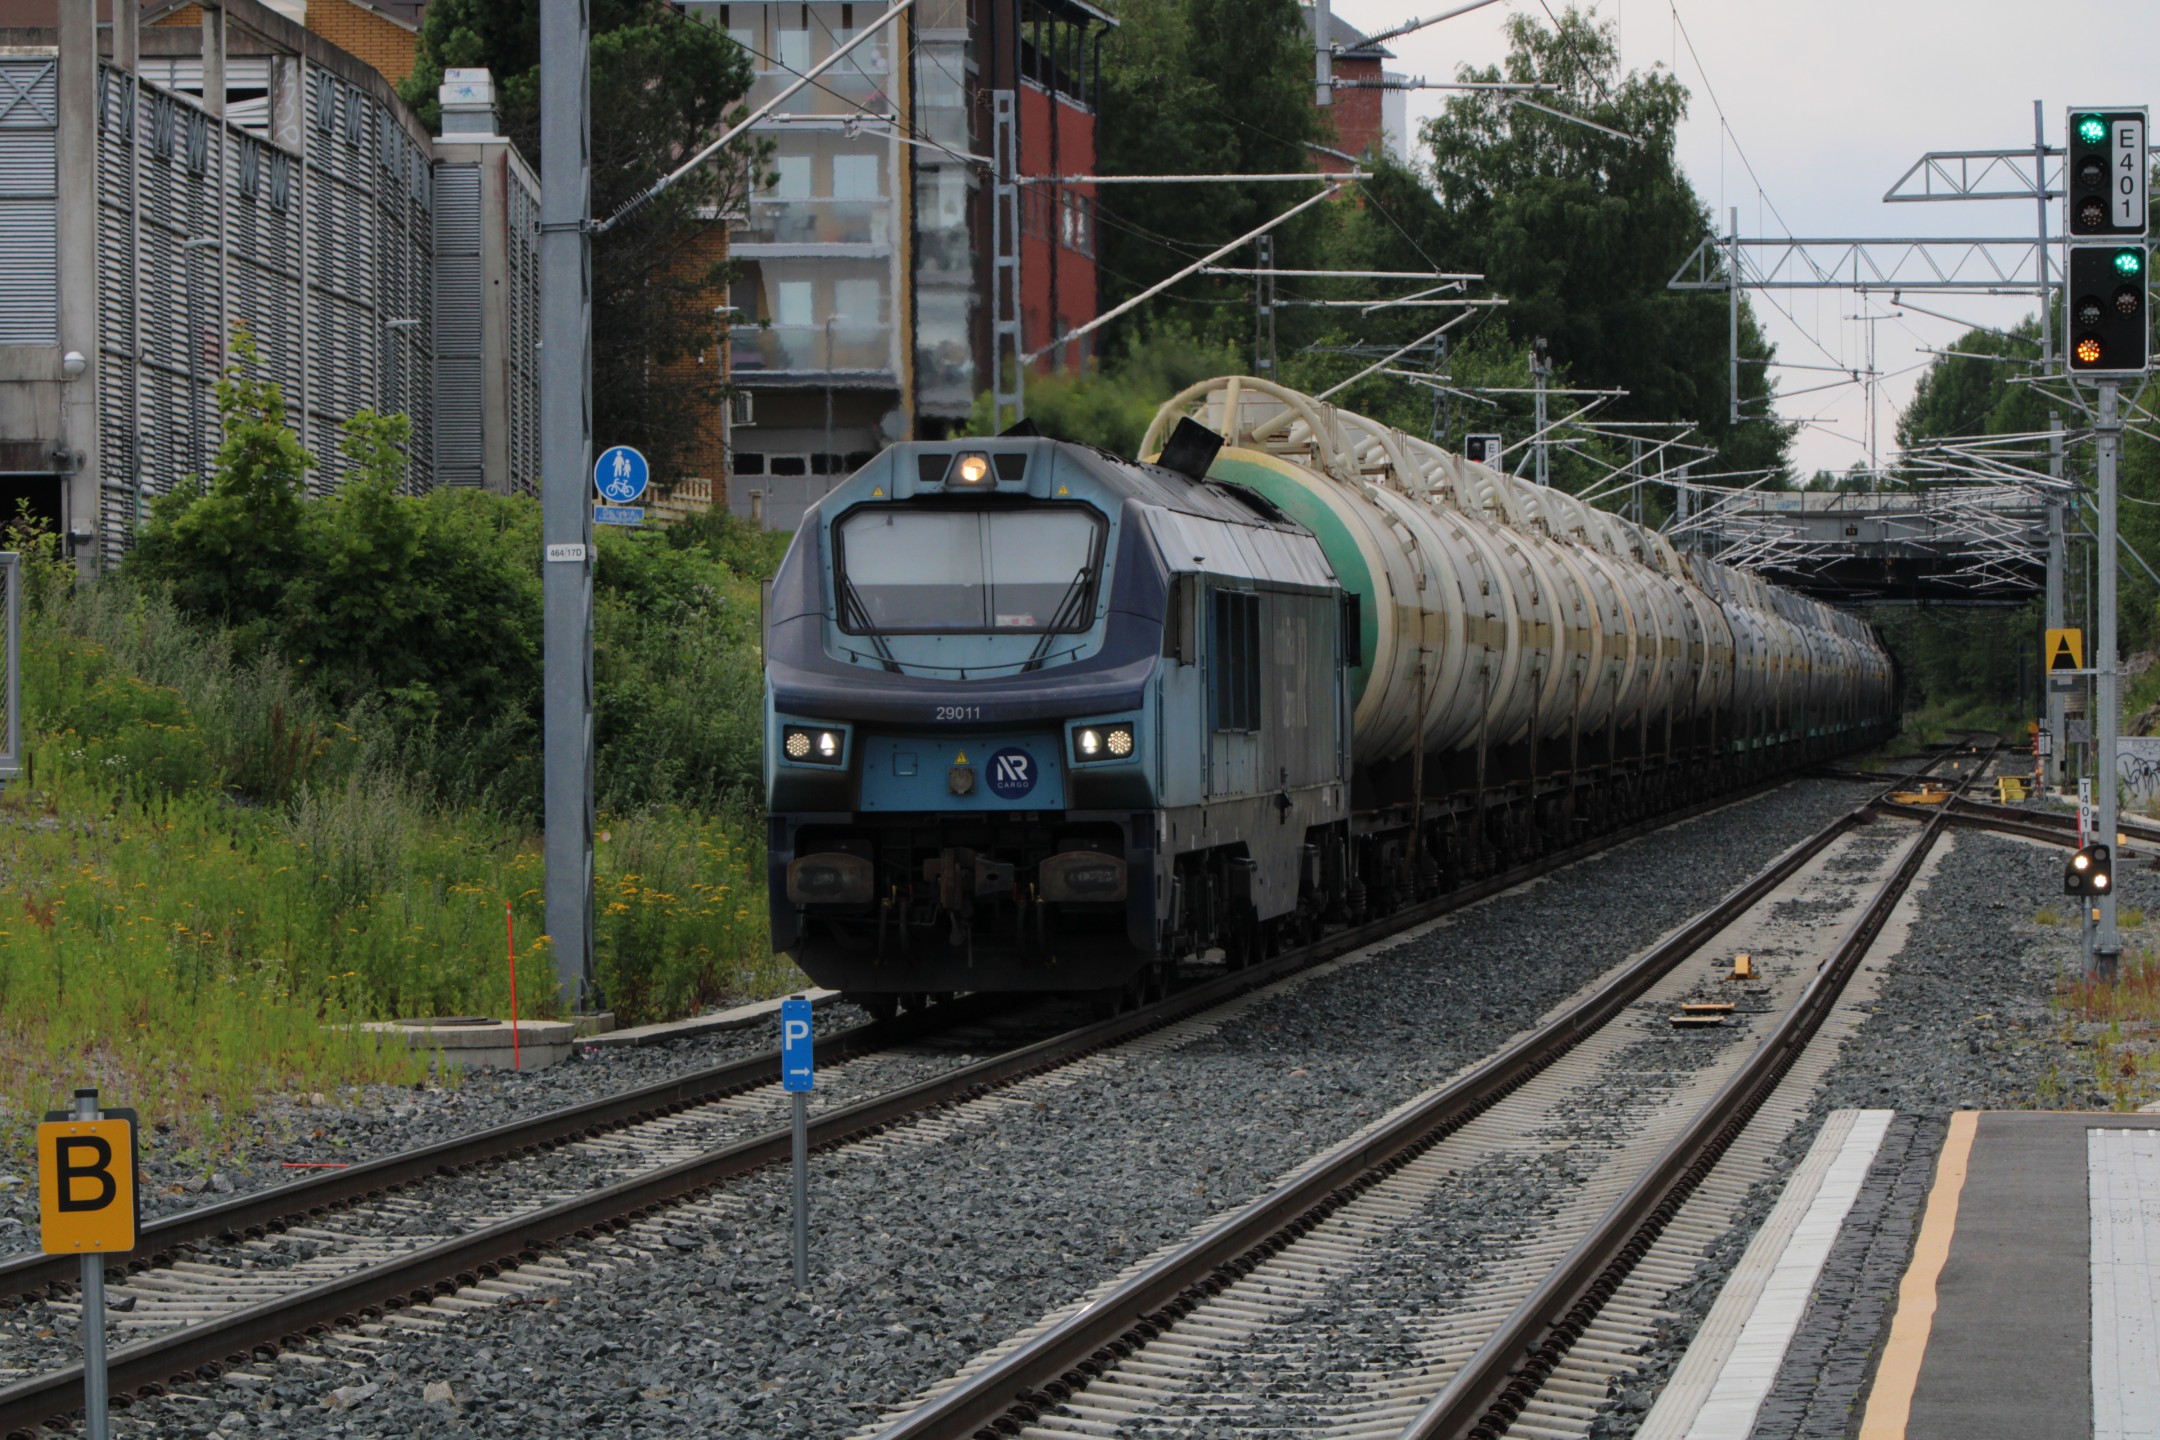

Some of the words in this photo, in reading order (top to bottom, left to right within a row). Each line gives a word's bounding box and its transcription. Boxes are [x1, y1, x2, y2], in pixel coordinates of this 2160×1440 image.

[2119, 128, 2135, 218] E401
[2051, 635, 2078, 669] A
[936, 706, 980, 720] 29011
[997, 755, 1028, 781] NR
[997, 781, 1029, 789] CARGO
[2081, 782, 2090, 828] T401
[785, 1020, 809, 1050] P
[56, 1136, 117, 1213] B
